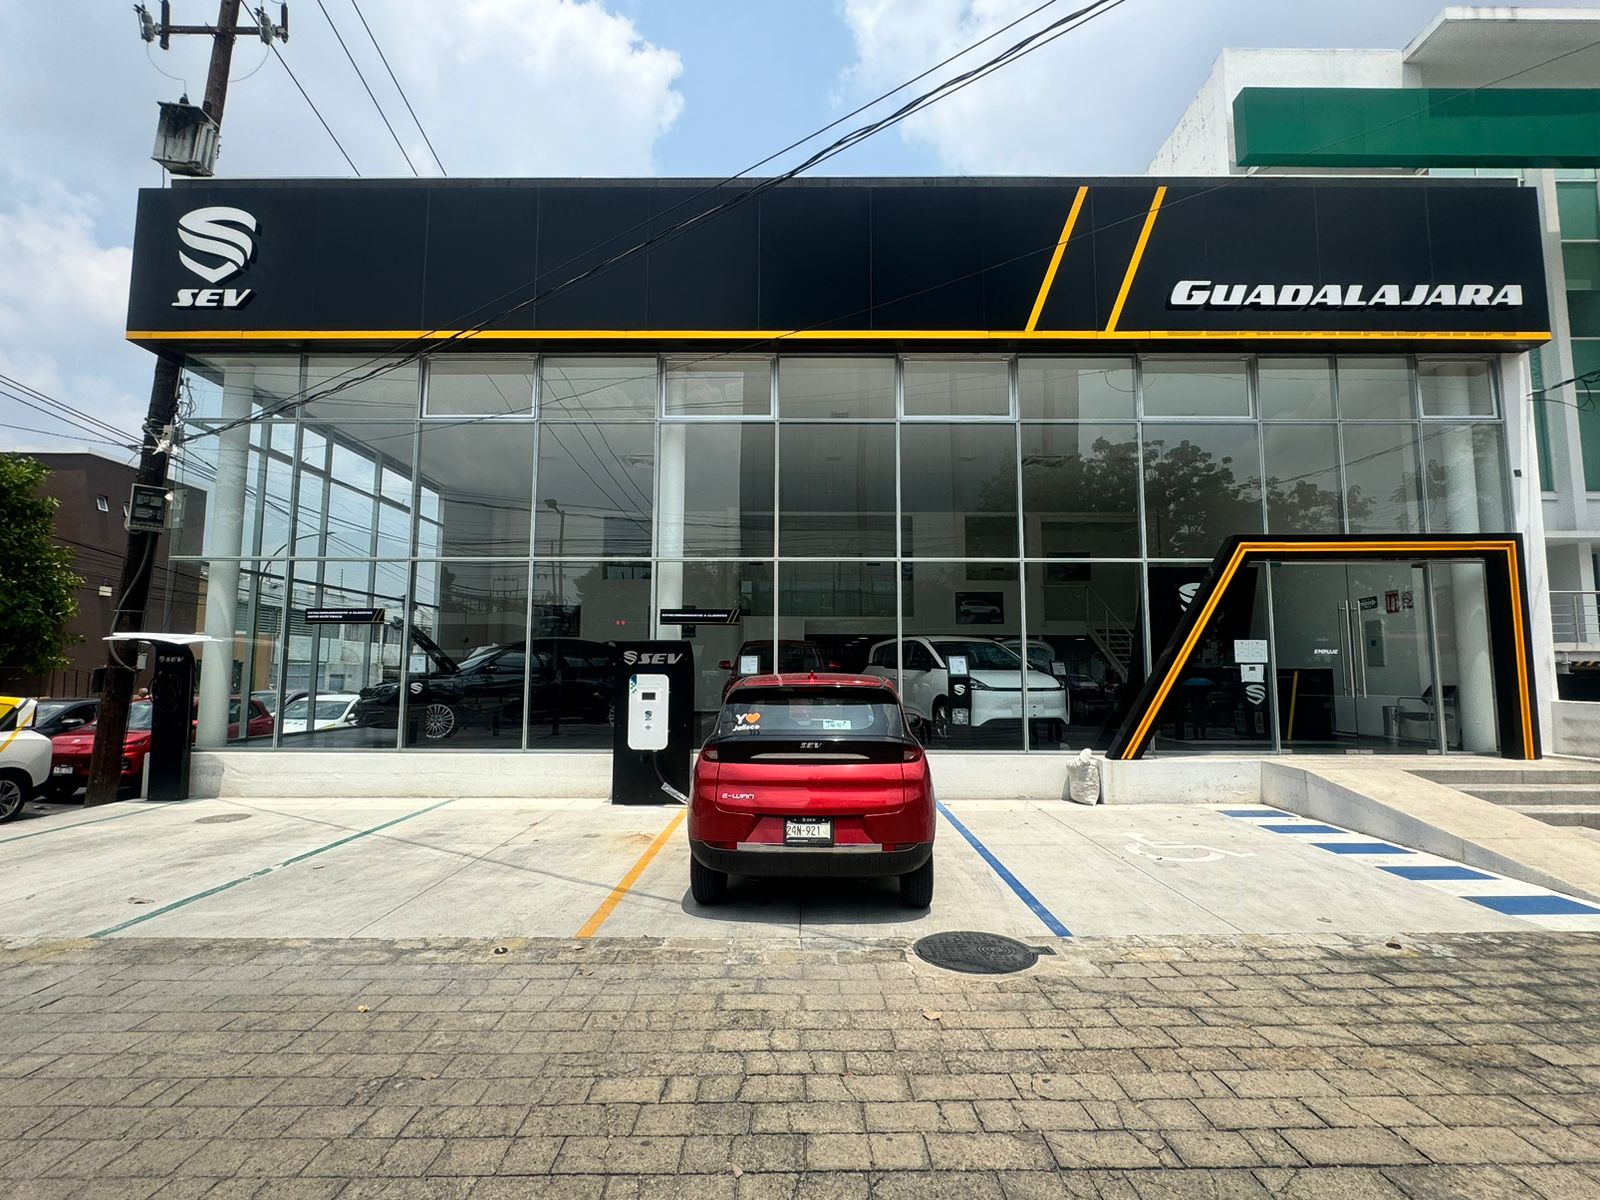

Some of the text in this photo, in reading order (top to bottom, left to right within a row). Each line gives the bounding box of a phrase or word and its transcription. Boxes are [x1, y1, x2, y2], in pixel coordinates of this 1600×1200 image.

[171, 288, 252, 306] SEV
[1170, 280, 1524, 306] GUADALAJARA
[638, 653, 683, 664] SEV
[786, 825, 821, 836] 24N-921
